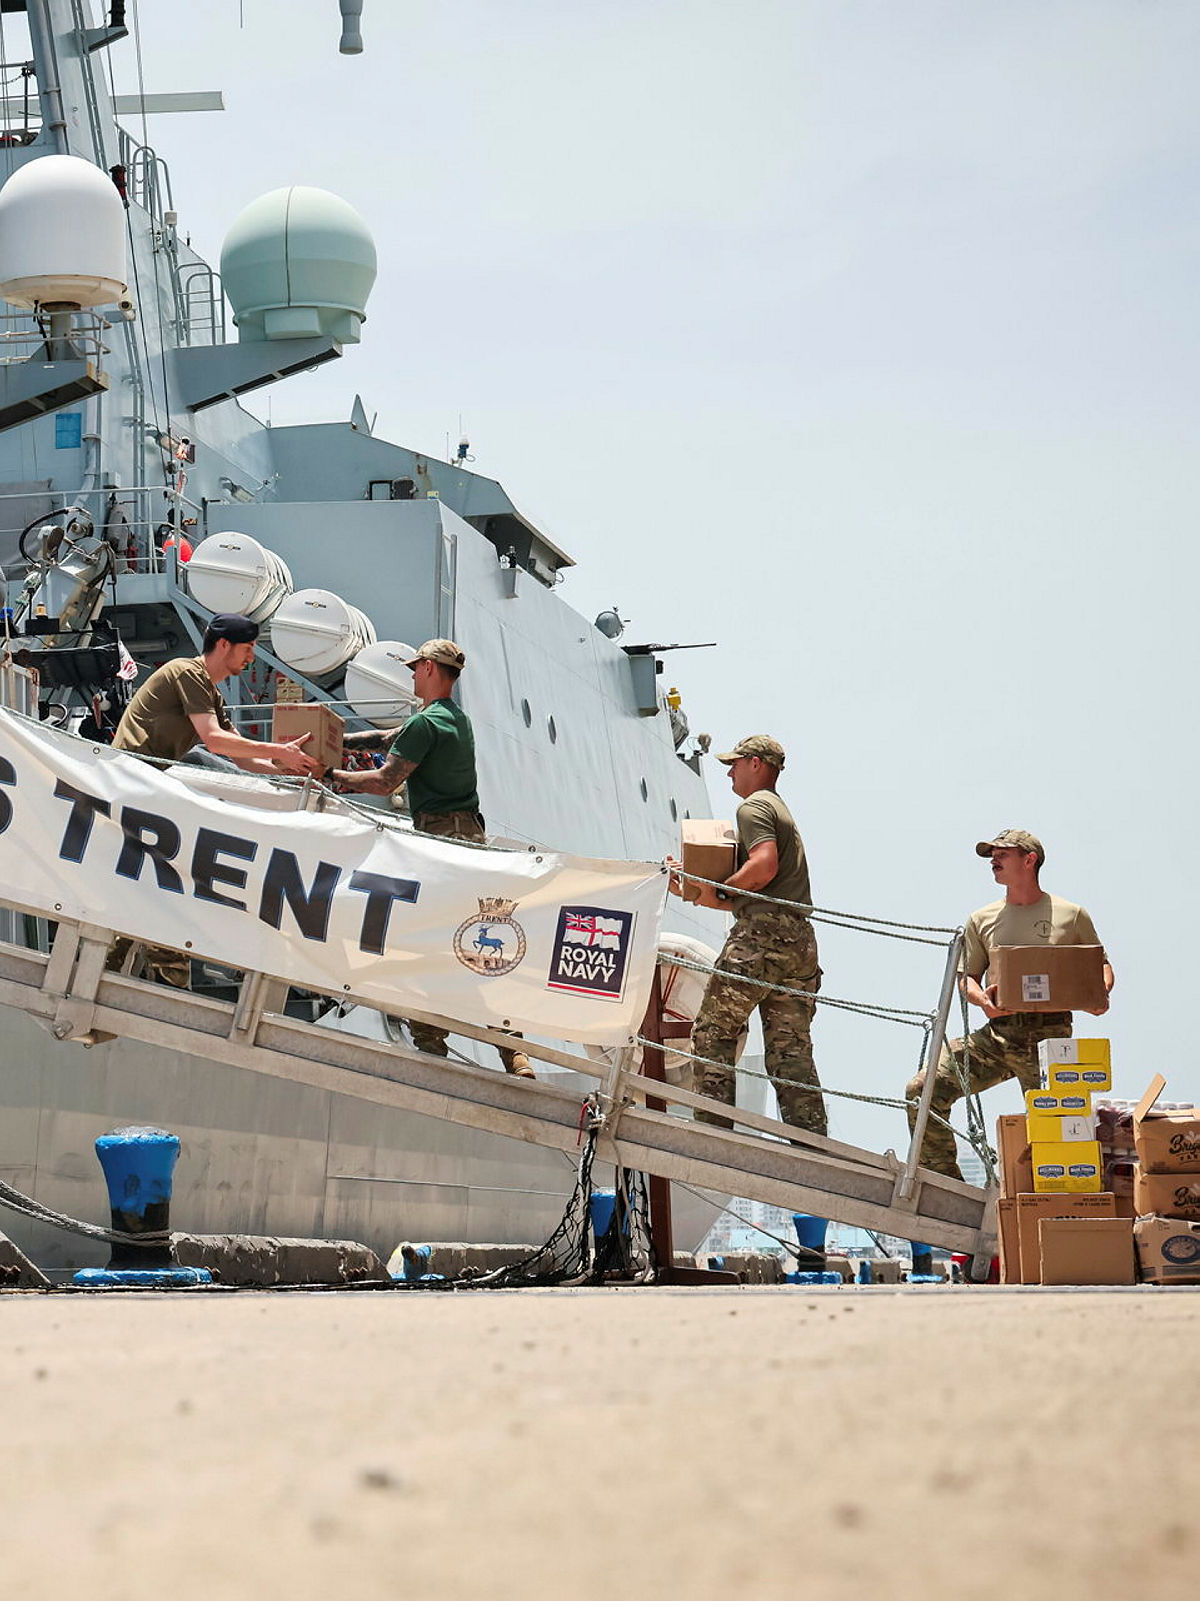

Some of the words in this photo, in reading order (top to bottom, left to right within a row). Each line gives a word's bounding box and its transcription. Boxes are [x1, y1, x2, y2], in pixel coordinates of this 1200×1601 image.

[54, 777, 422, 956] TRENT
[481, 914, 509, 923] TRENT
[561, 946, 617, 968] ROYAL
[558, 960, 615, 983] NAVY
